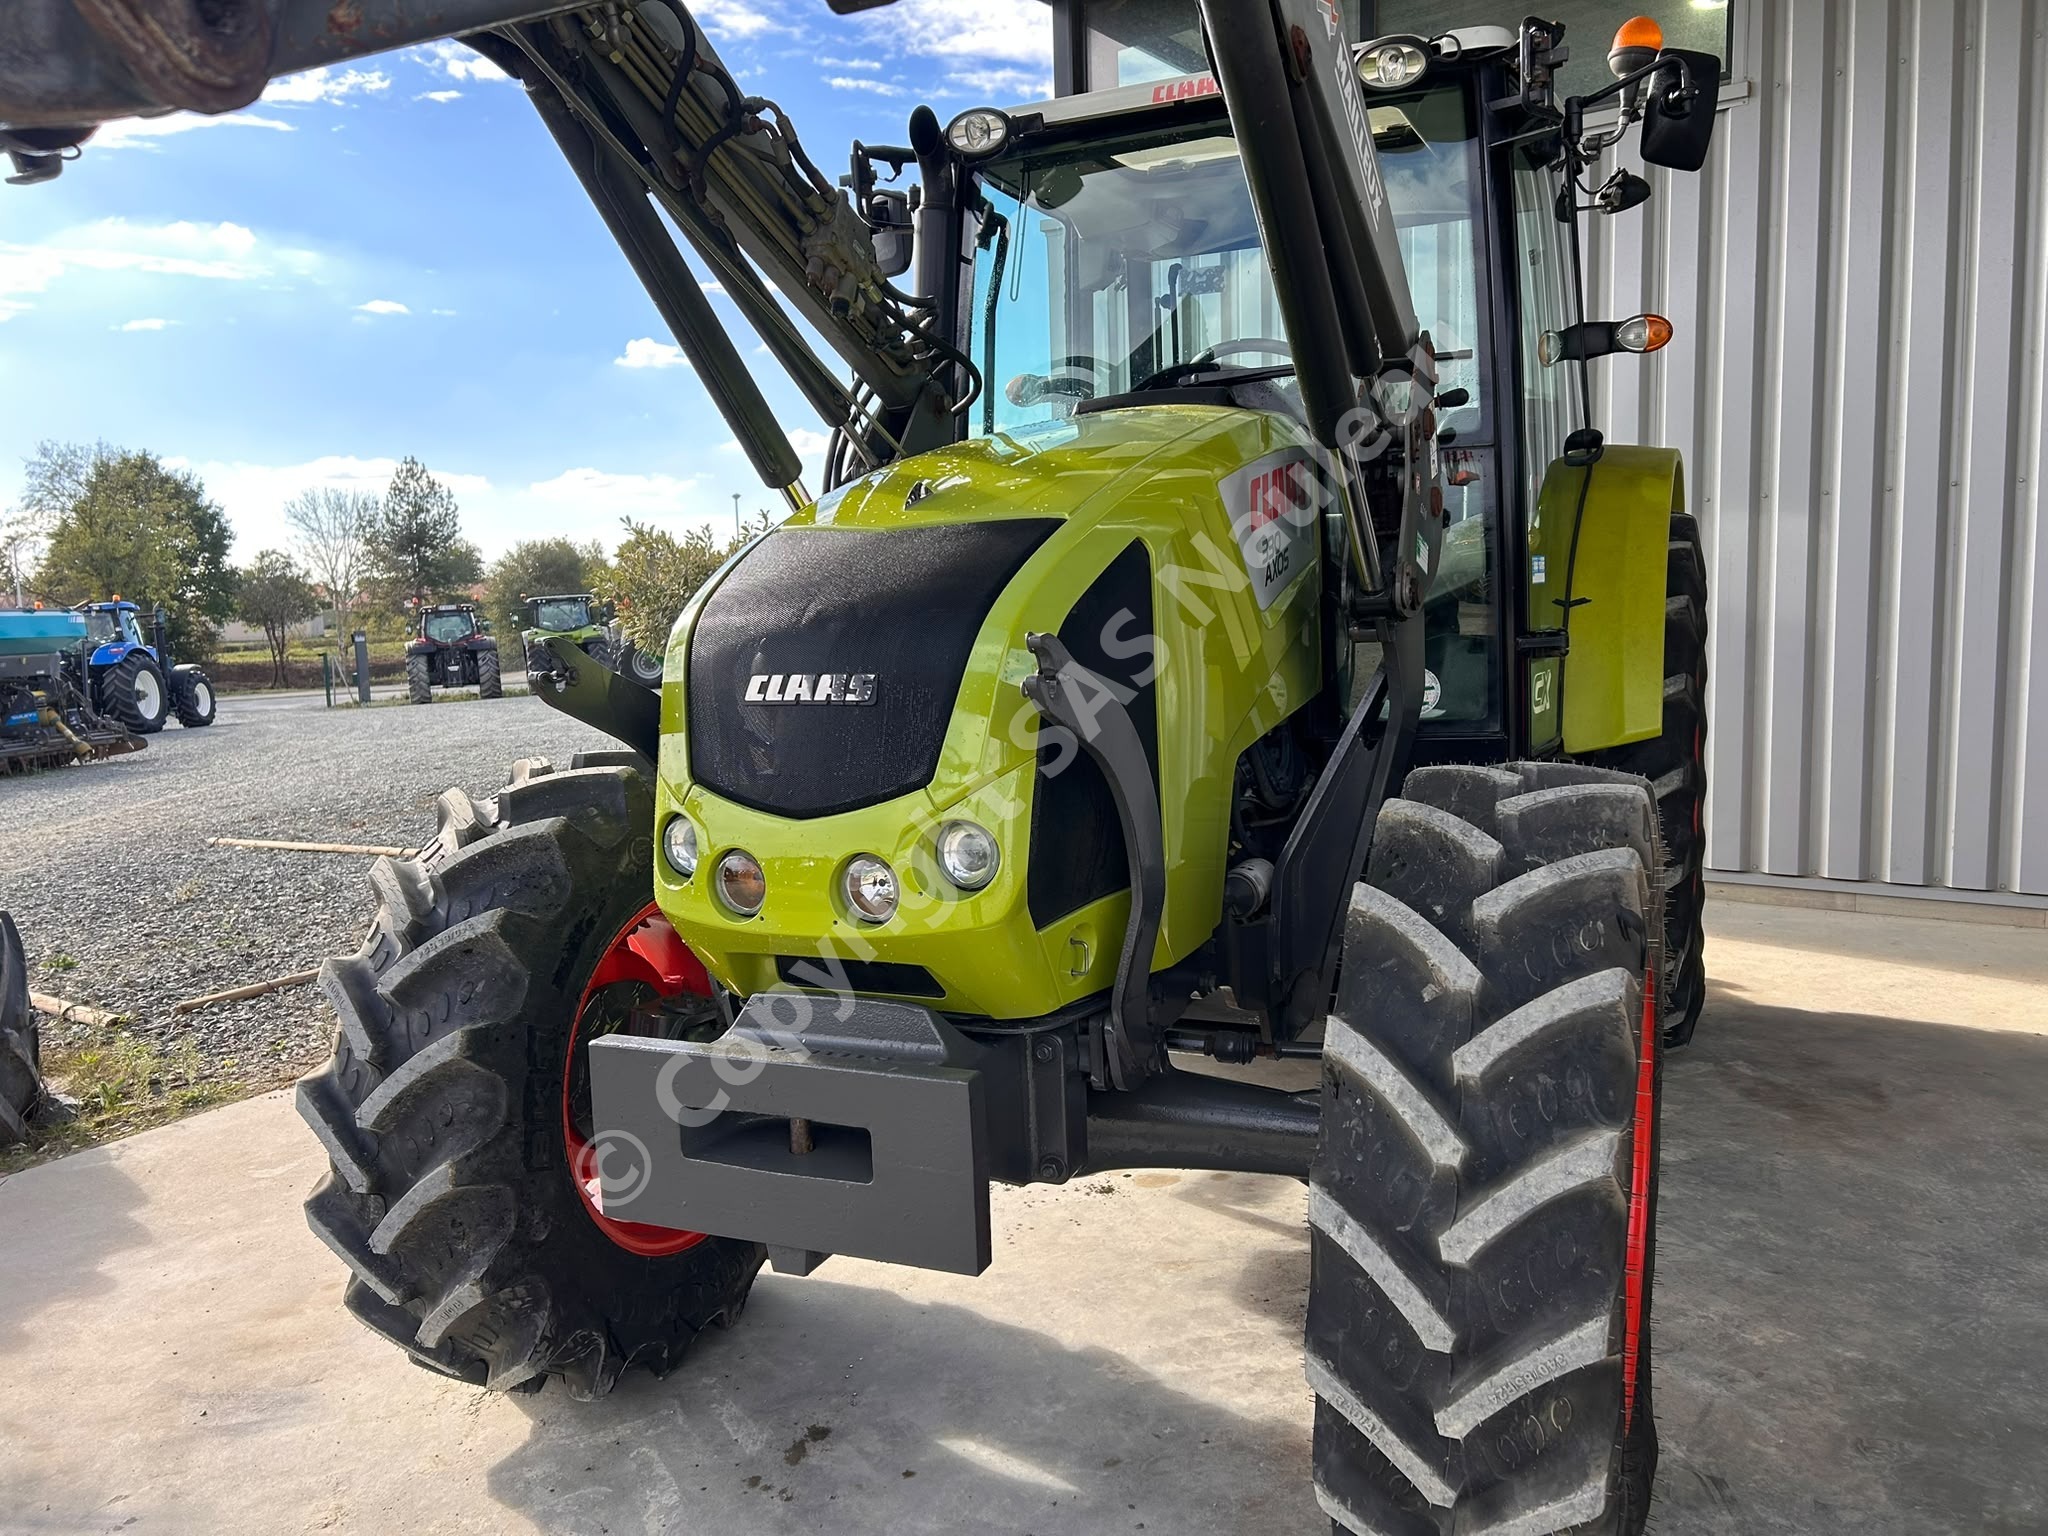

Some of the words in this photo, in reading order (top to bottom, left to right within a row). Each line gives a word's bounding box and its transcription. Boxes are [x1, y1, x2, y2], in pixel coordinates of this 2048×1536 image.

[1152, 76, 1220, 103] CLAA
[1335, 41, 1382, 223] MAILLEUX
[1264, 546, 1290, 587] AXOS
[744, 673, 876, 702] CLAAS
[1333, 1391, 1382, 1441] RADIAL
